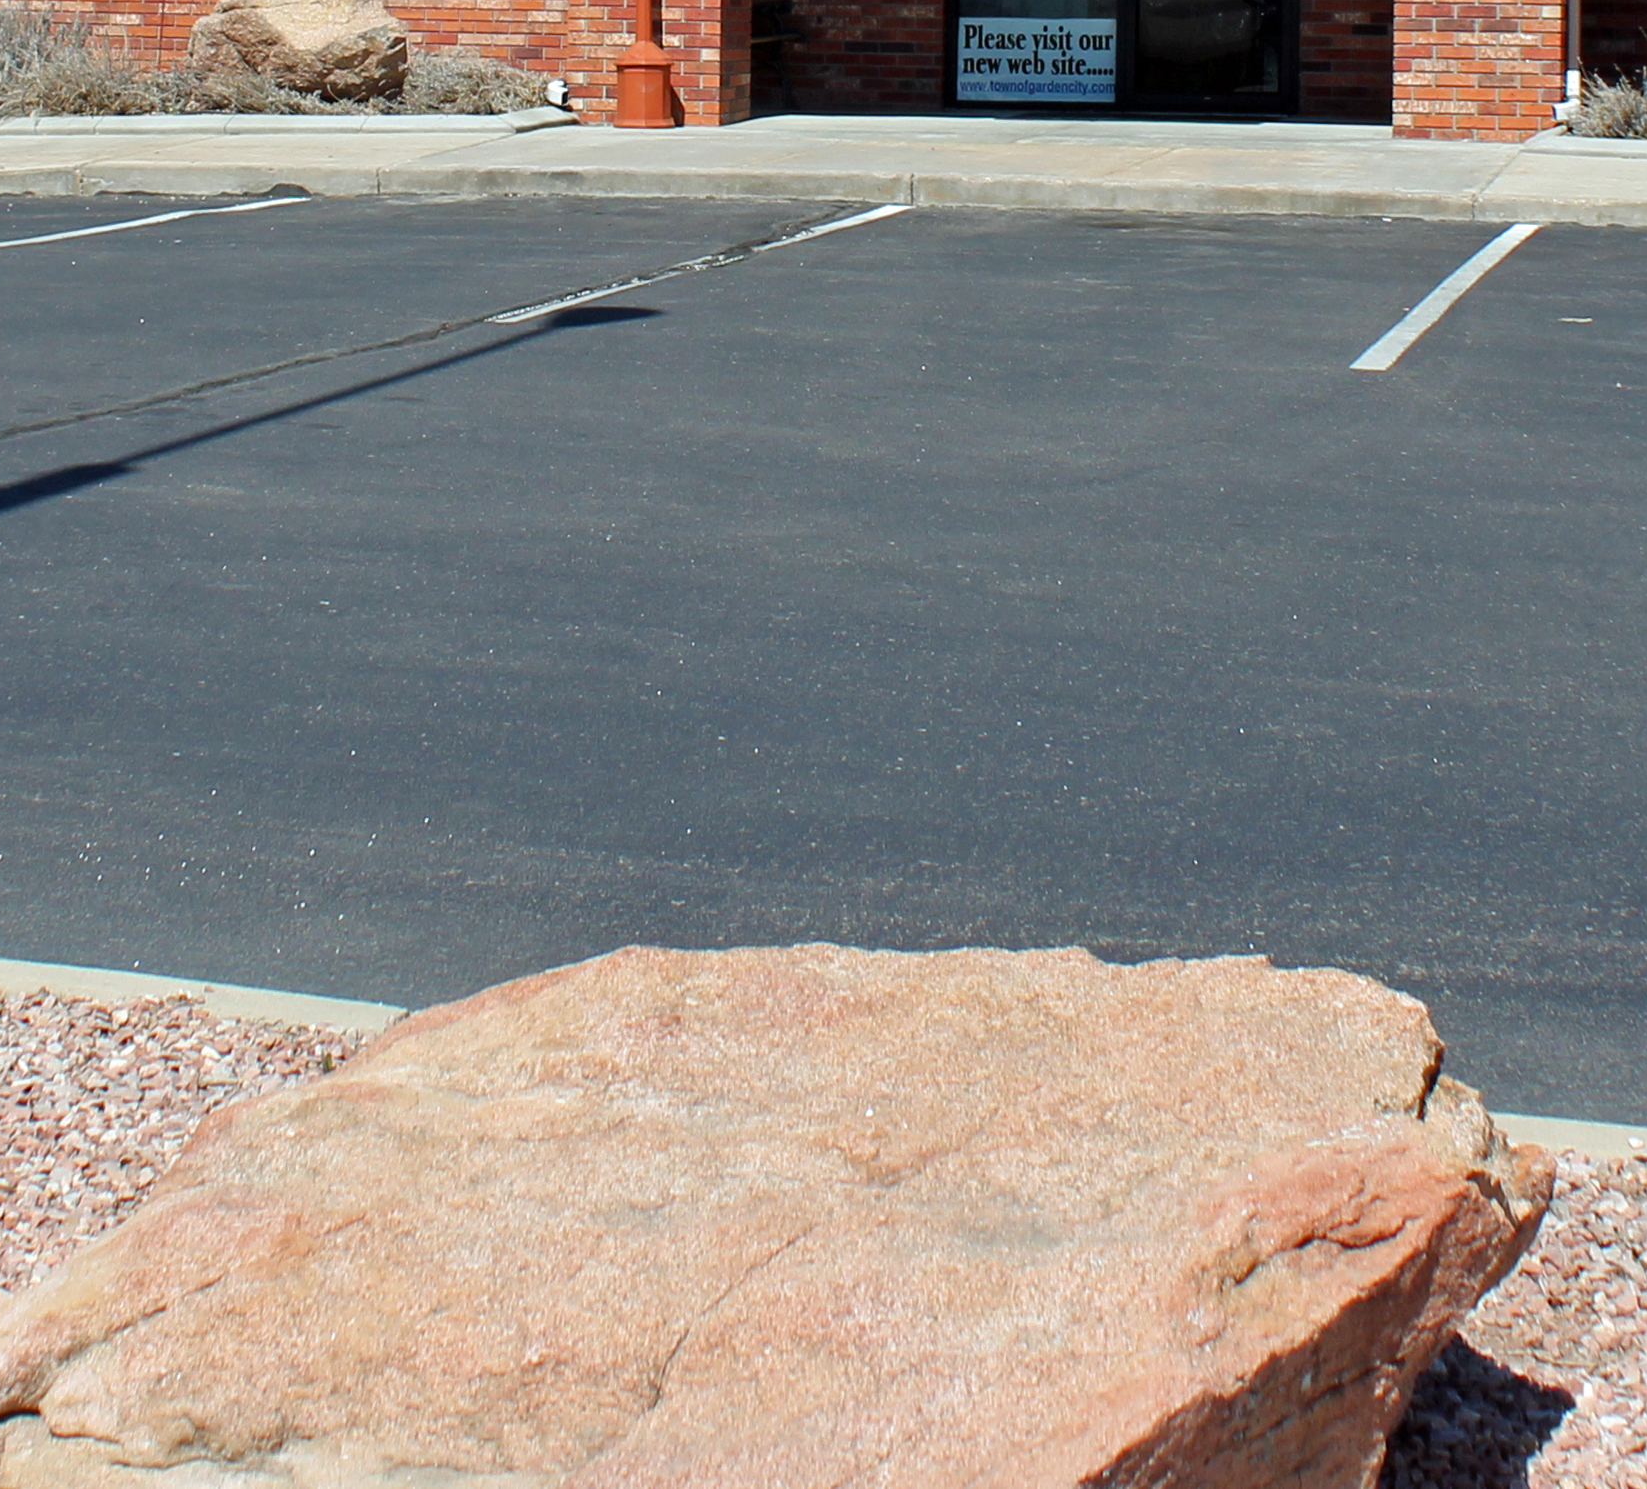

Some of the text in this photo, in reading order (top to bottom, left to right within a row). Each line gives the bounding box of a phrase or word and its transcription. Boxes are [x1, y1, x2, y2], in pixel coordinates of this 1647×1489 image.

[964, 24, 1114, 51] Please visit our
[962, 57, 1003, 74] new
[1007, 51, 1045, 74] web
[960, 79, 1115, 95] www.townofgardencity.com
